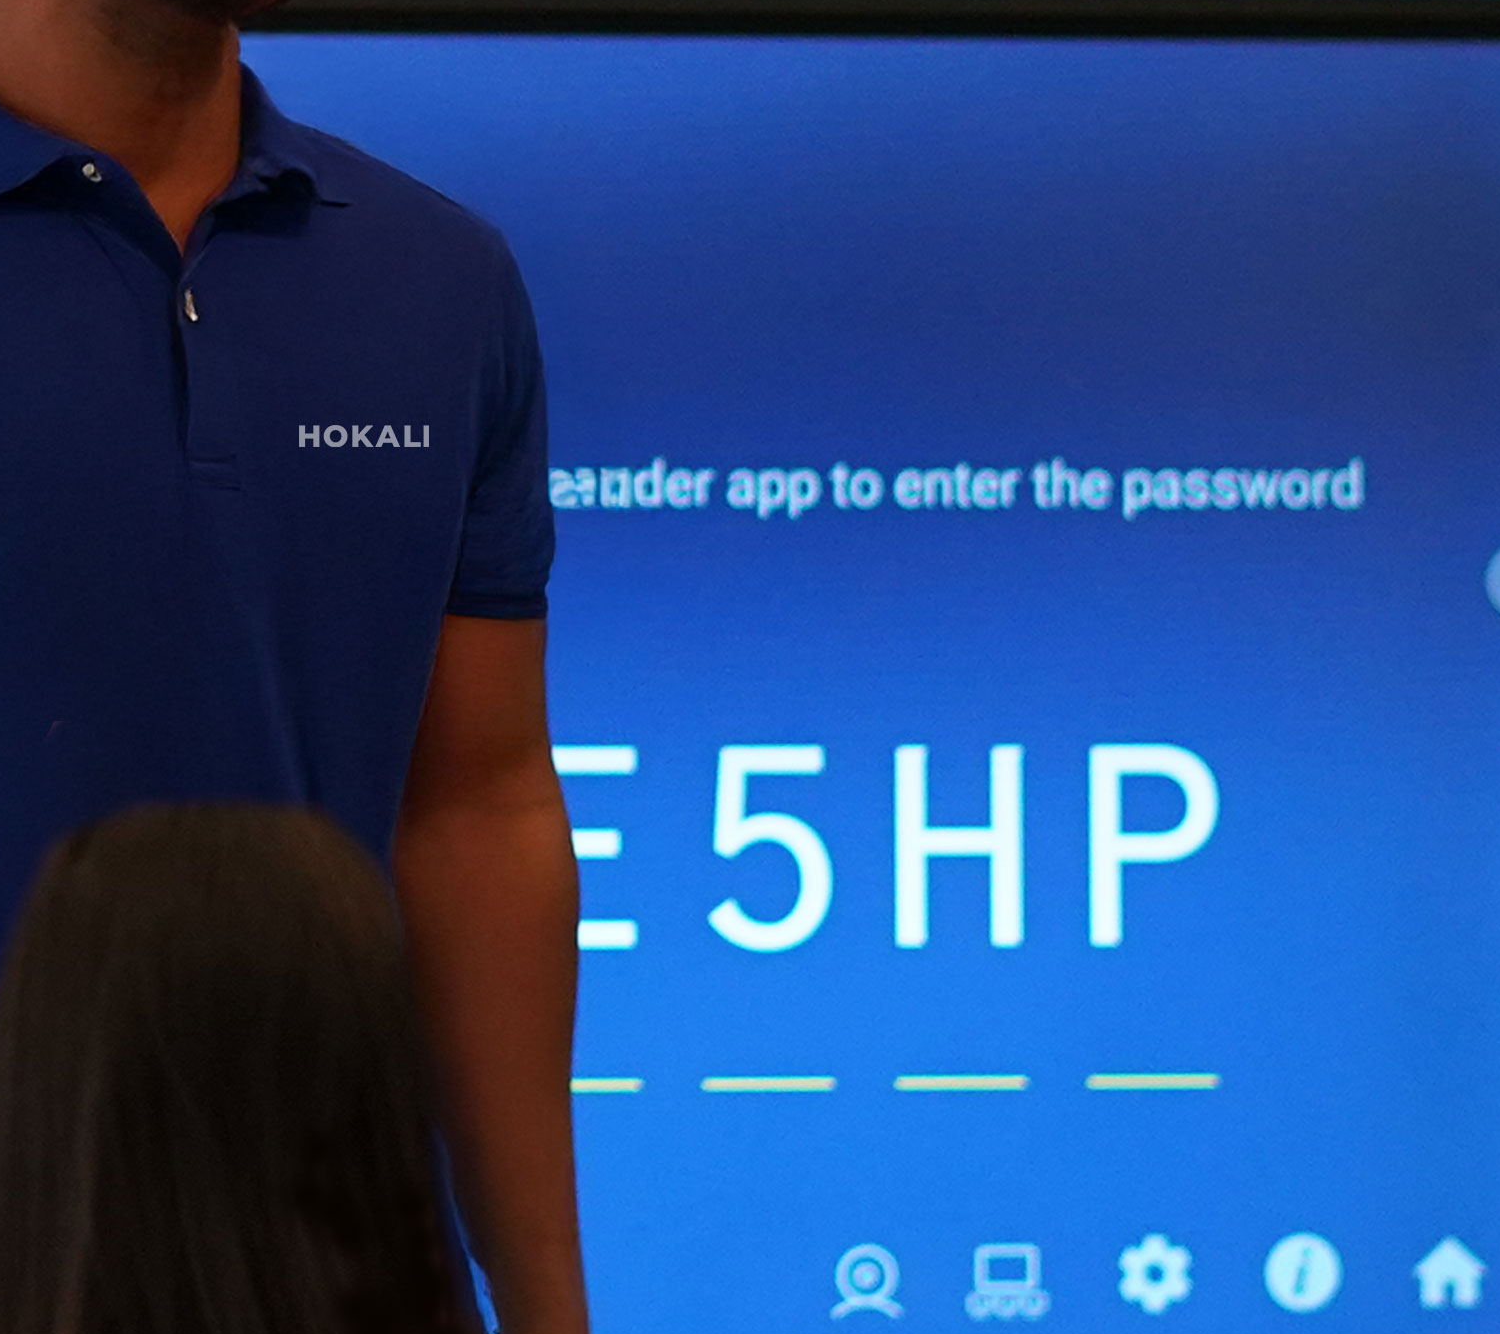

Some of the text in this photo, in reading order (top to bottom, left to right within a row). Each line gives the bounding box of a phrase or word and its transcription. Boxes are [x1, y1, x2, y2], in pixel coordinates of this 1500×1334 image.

[298, 424, 430, 448] HOKALI
[726, 466, 822, 520] app
[830, 461, 884, 510] to
[893, 461, 1021, 510] enter
[1033, 455, 1114, 510] the
[1122, 454, 1366, 521] password
